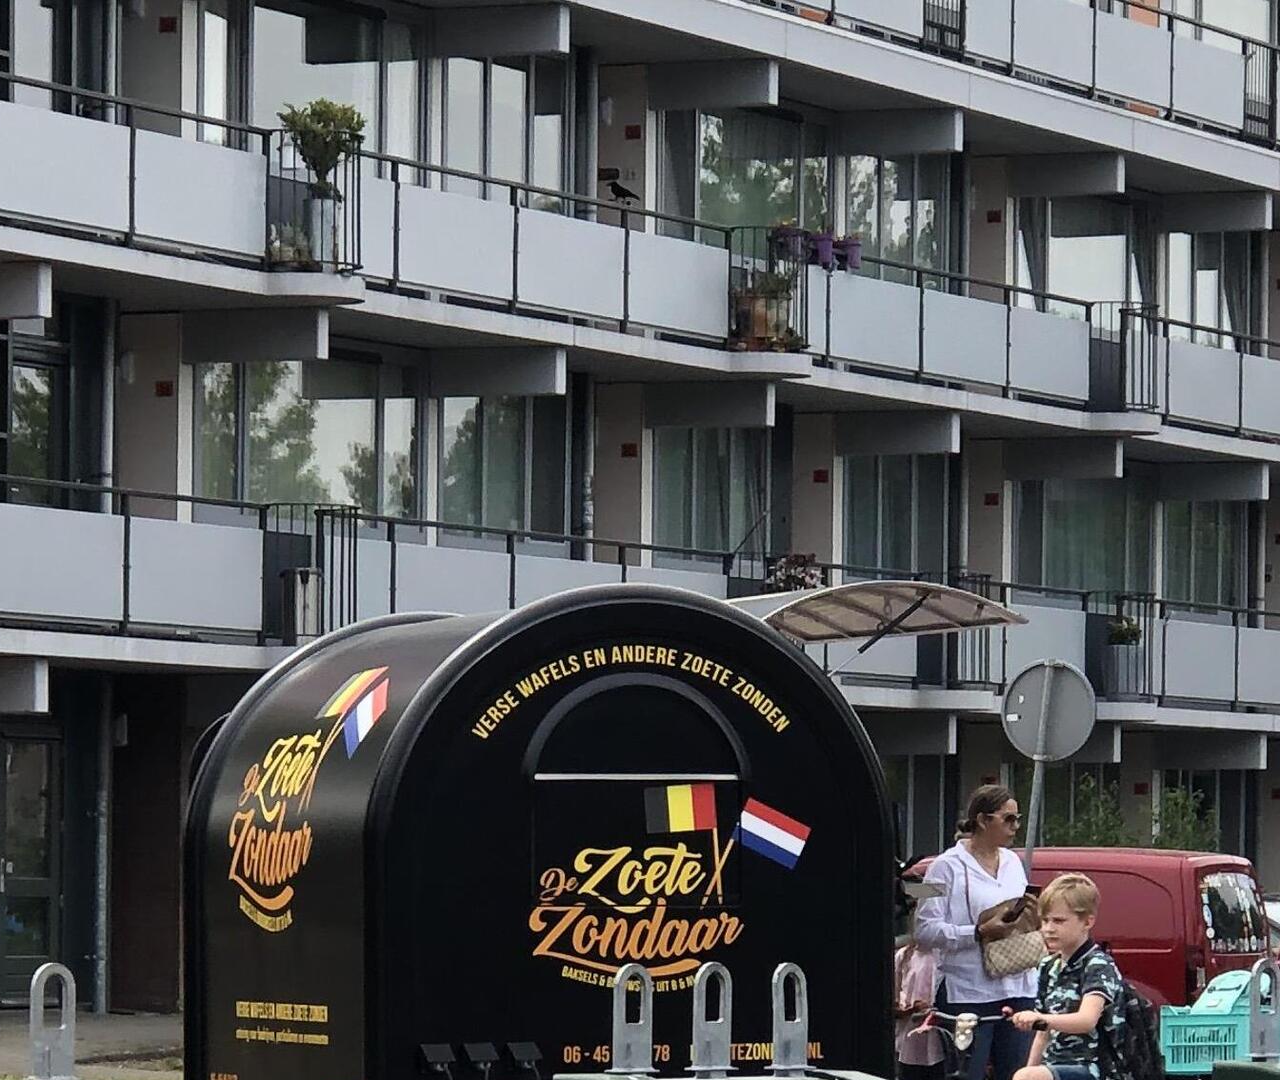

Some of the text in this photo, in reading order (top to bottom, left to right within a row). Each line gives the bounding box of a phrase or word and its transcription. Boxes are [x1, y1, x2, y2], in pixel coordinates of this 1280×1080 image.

[472, 645, 791, 739] VERSE WAFELS EN ANDERE ZOETE ZONDEN
[254, 729, 321, 822] Zoete
[229, 800, 313, 910] Zondaar
[540, 842, 706, 913] De Zoete
[528, 897, 744, 976] Zondaar
[561, 965, 598, 985] BAKSELS
[656, 980, 669, 992] UIT
[563, 1045, 581, 1063] 06
